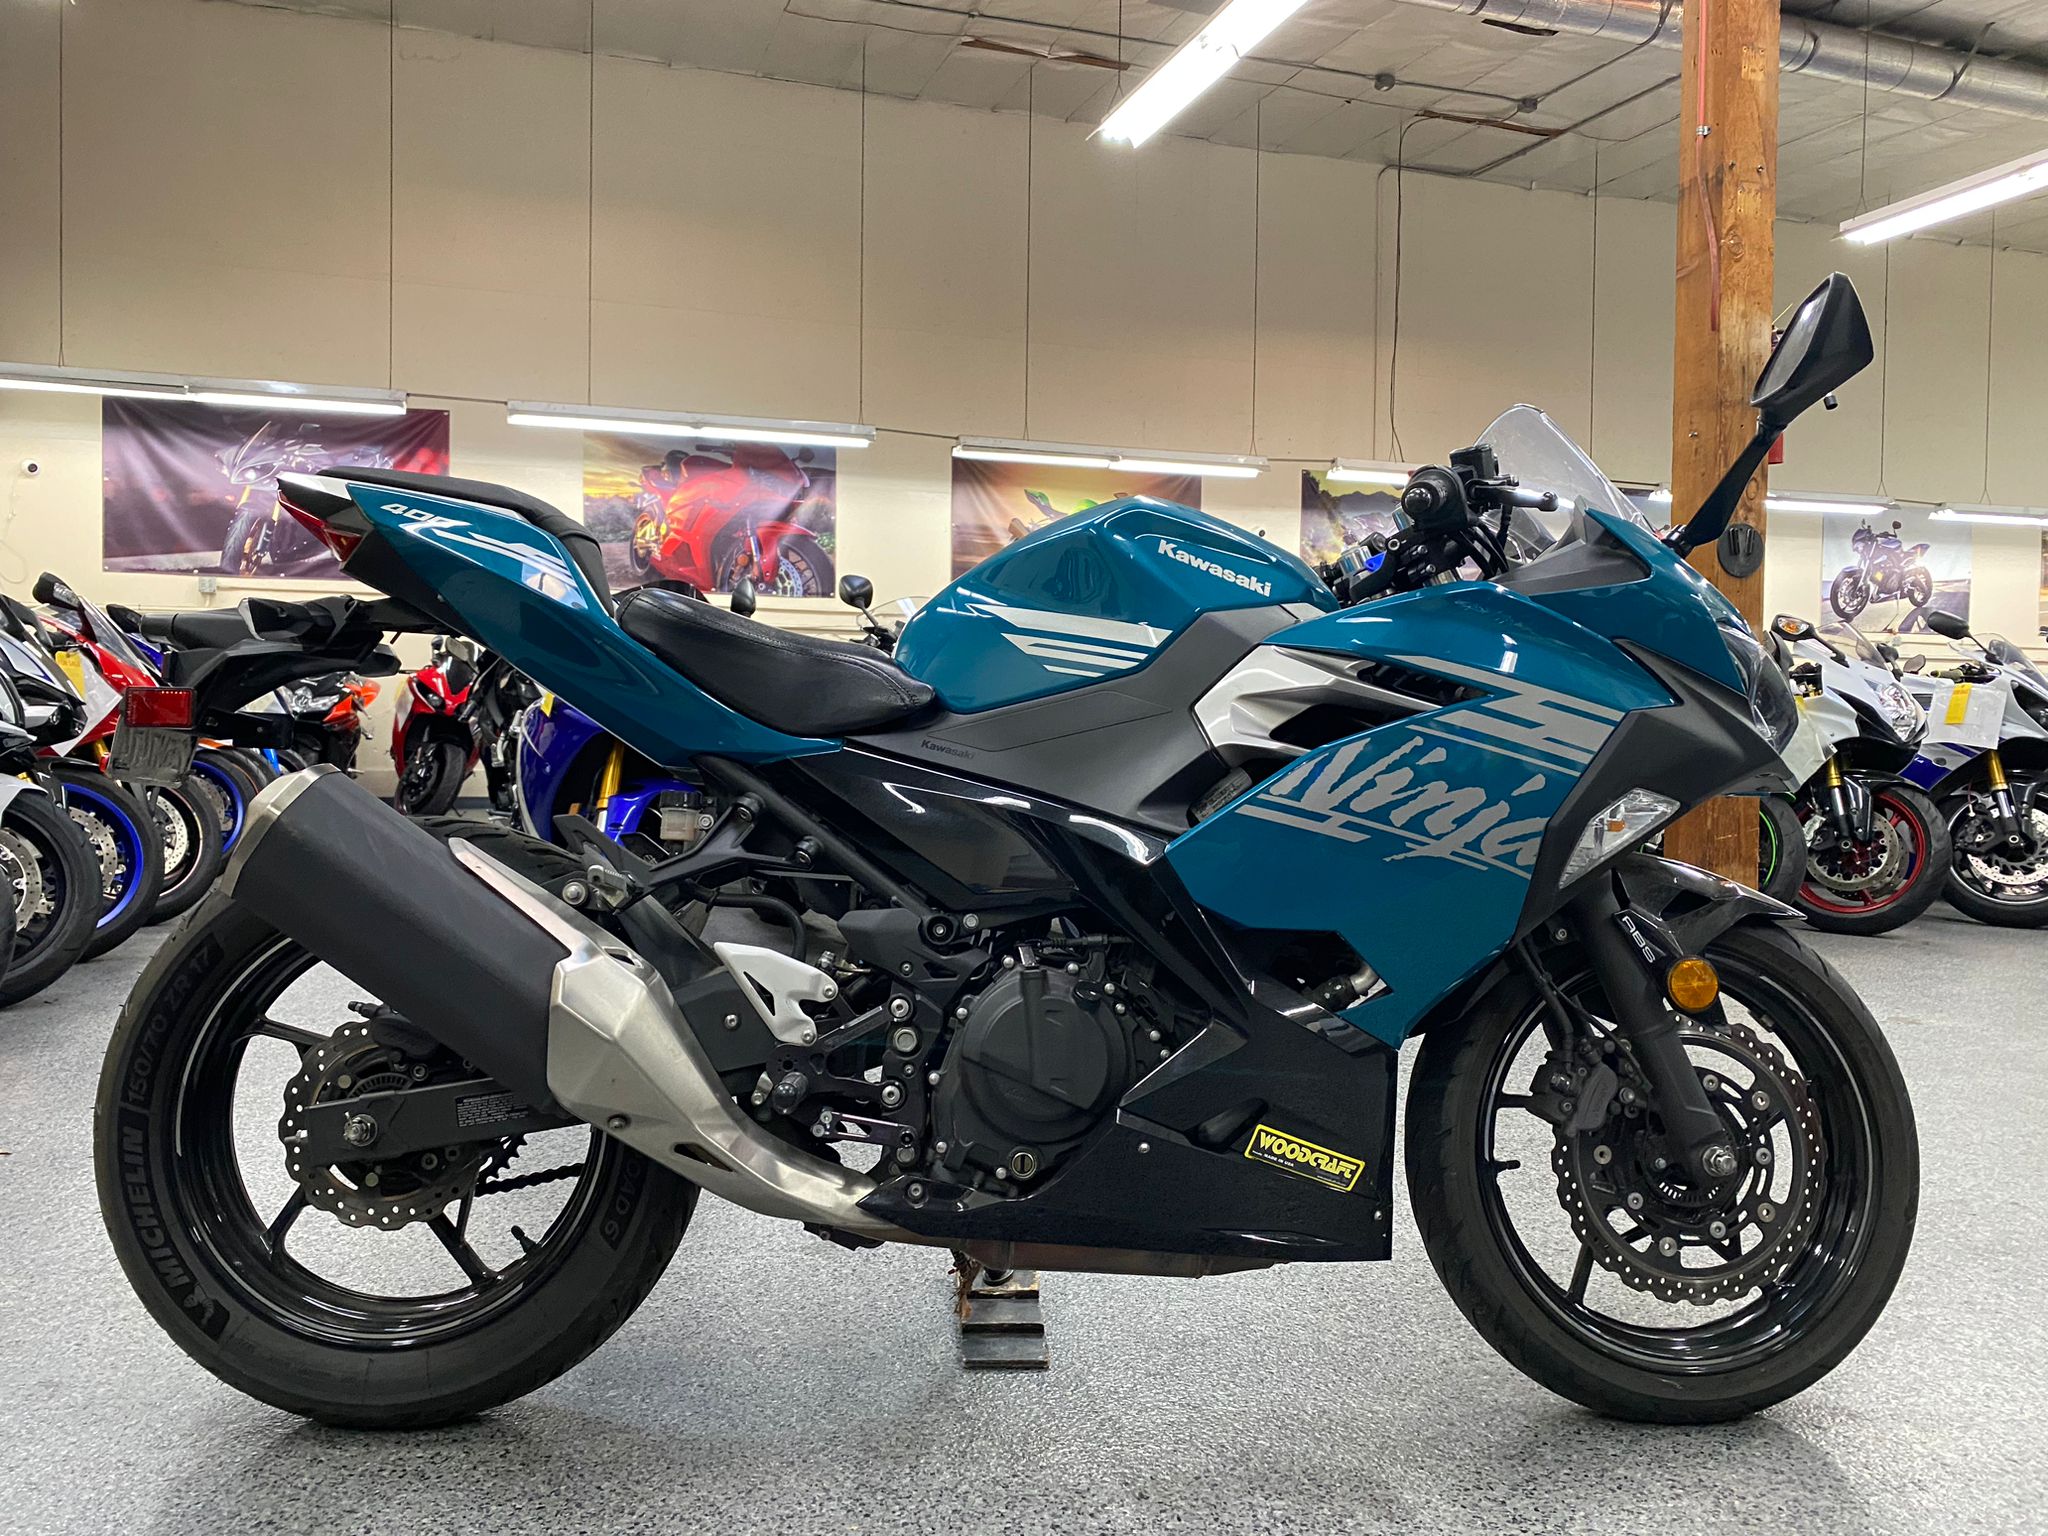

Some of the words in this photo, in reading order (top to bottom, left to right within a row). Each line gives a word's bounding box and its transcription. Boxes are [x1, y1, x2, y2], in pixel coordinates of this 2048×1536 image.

[1158, 539, 1271, 597] Kawasaki
[921, 740, 976, 759] Kawasaki
[1269, 736, 1550, 866] Ninja
[1621, 915, 1656, 963] ABS
[128, 1013, 168, 1104] 150/70
[164, 974, 191, 1012] ZR
[188, 945, 210, 971] 17
[1260, 1131, 1357, 1178] WOODCRAFT
[121, 1125, 190, 1288] MICHELIN
